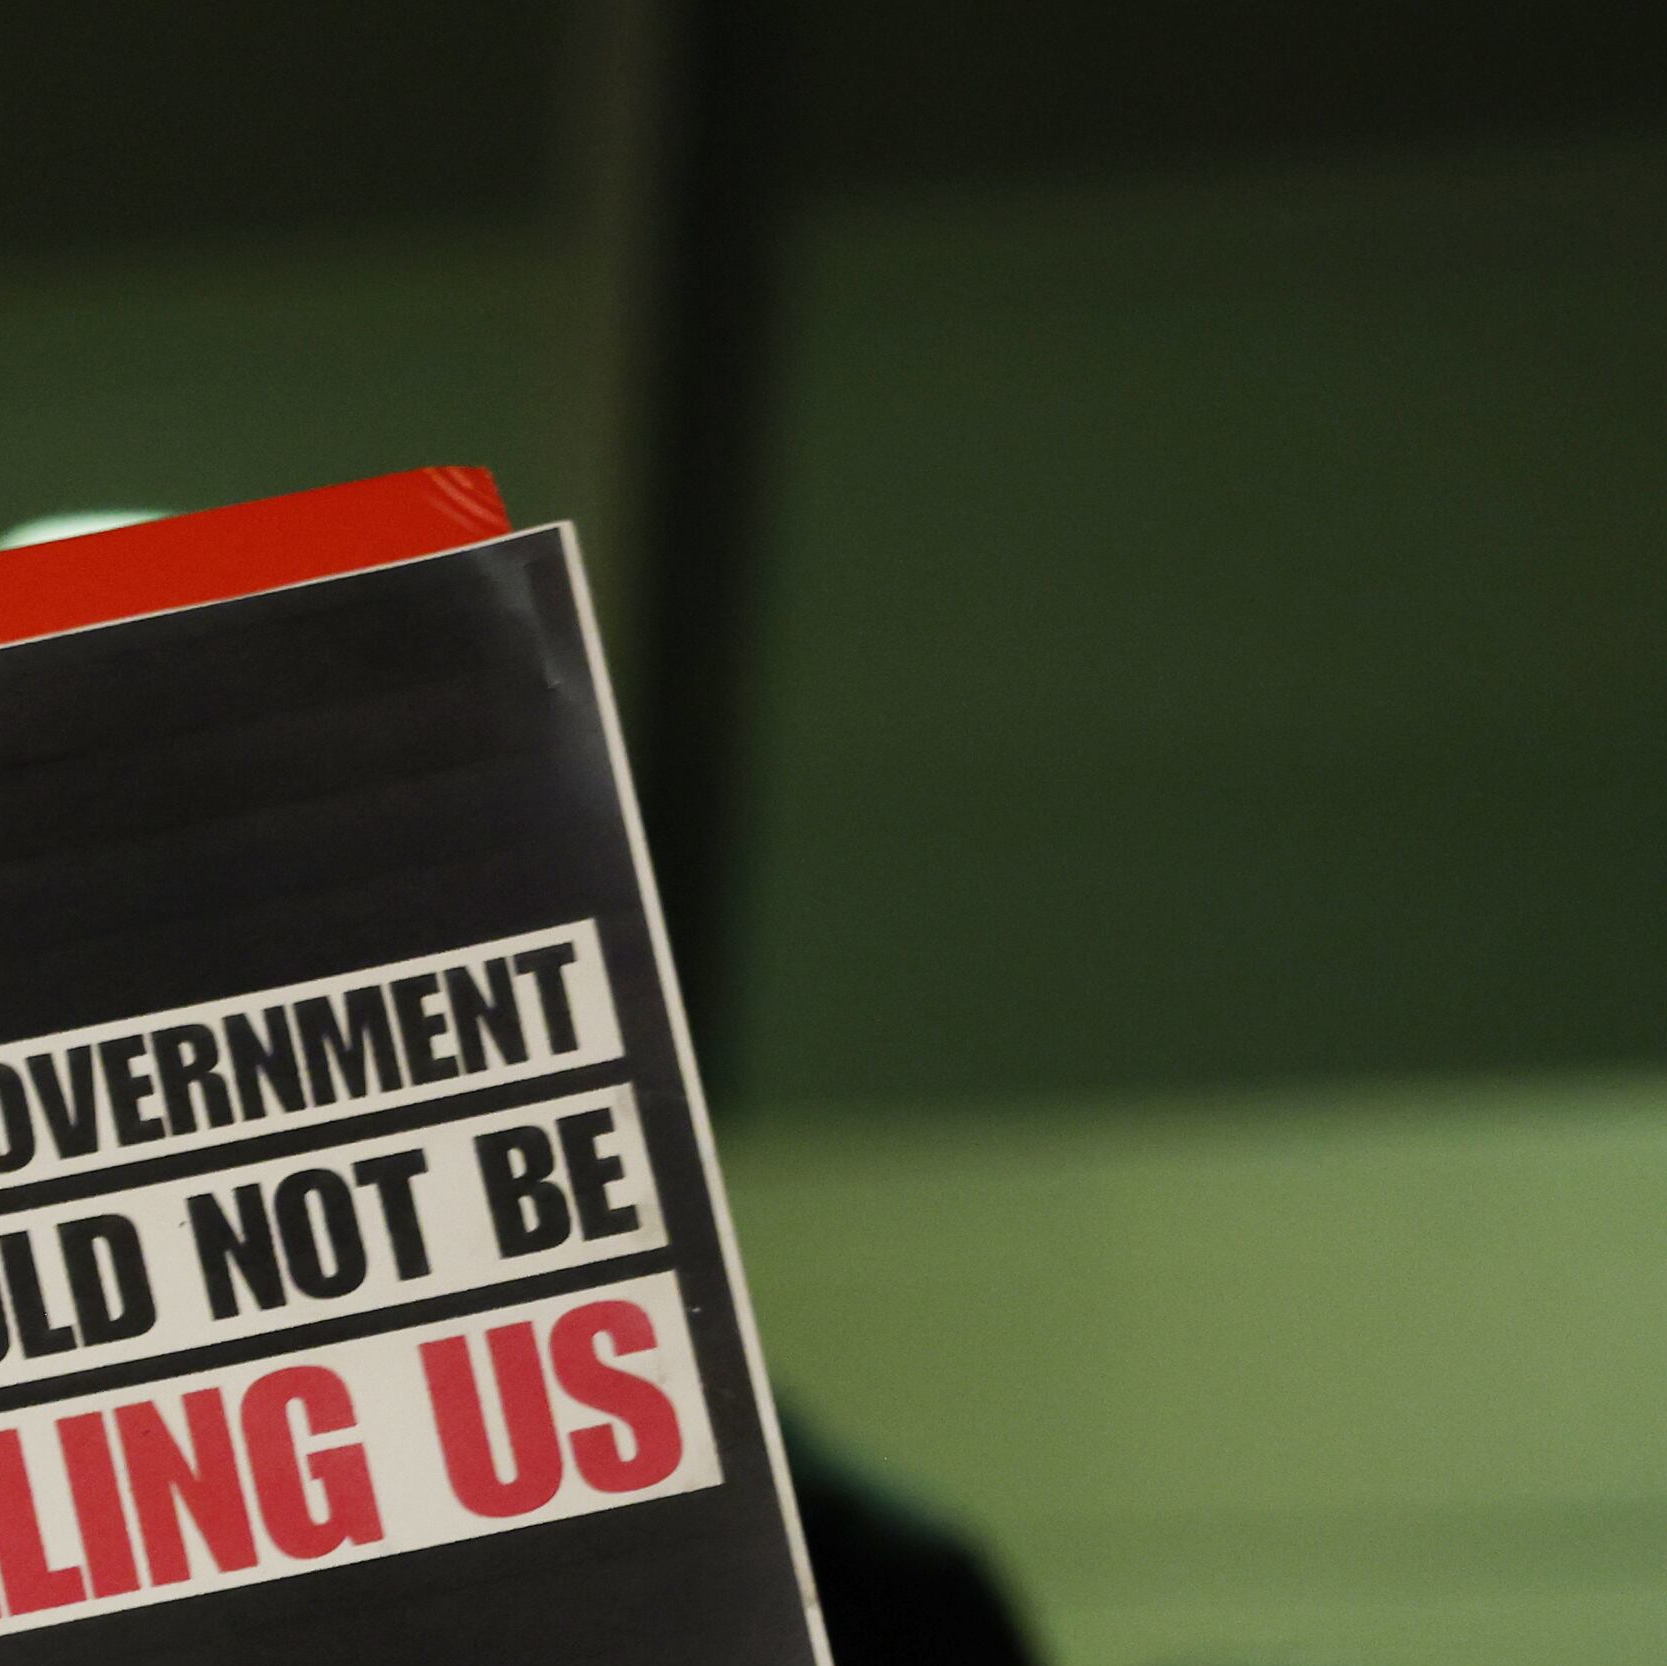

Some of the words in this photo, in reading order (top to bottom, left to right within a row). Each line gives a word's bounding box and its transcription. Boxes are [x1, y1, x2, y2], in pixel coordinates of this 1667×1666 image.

[184, 1149, 435, 1323] NOT
[473, 1107, 645, 1262] BE
[418, 1299, 685, 1521] US
